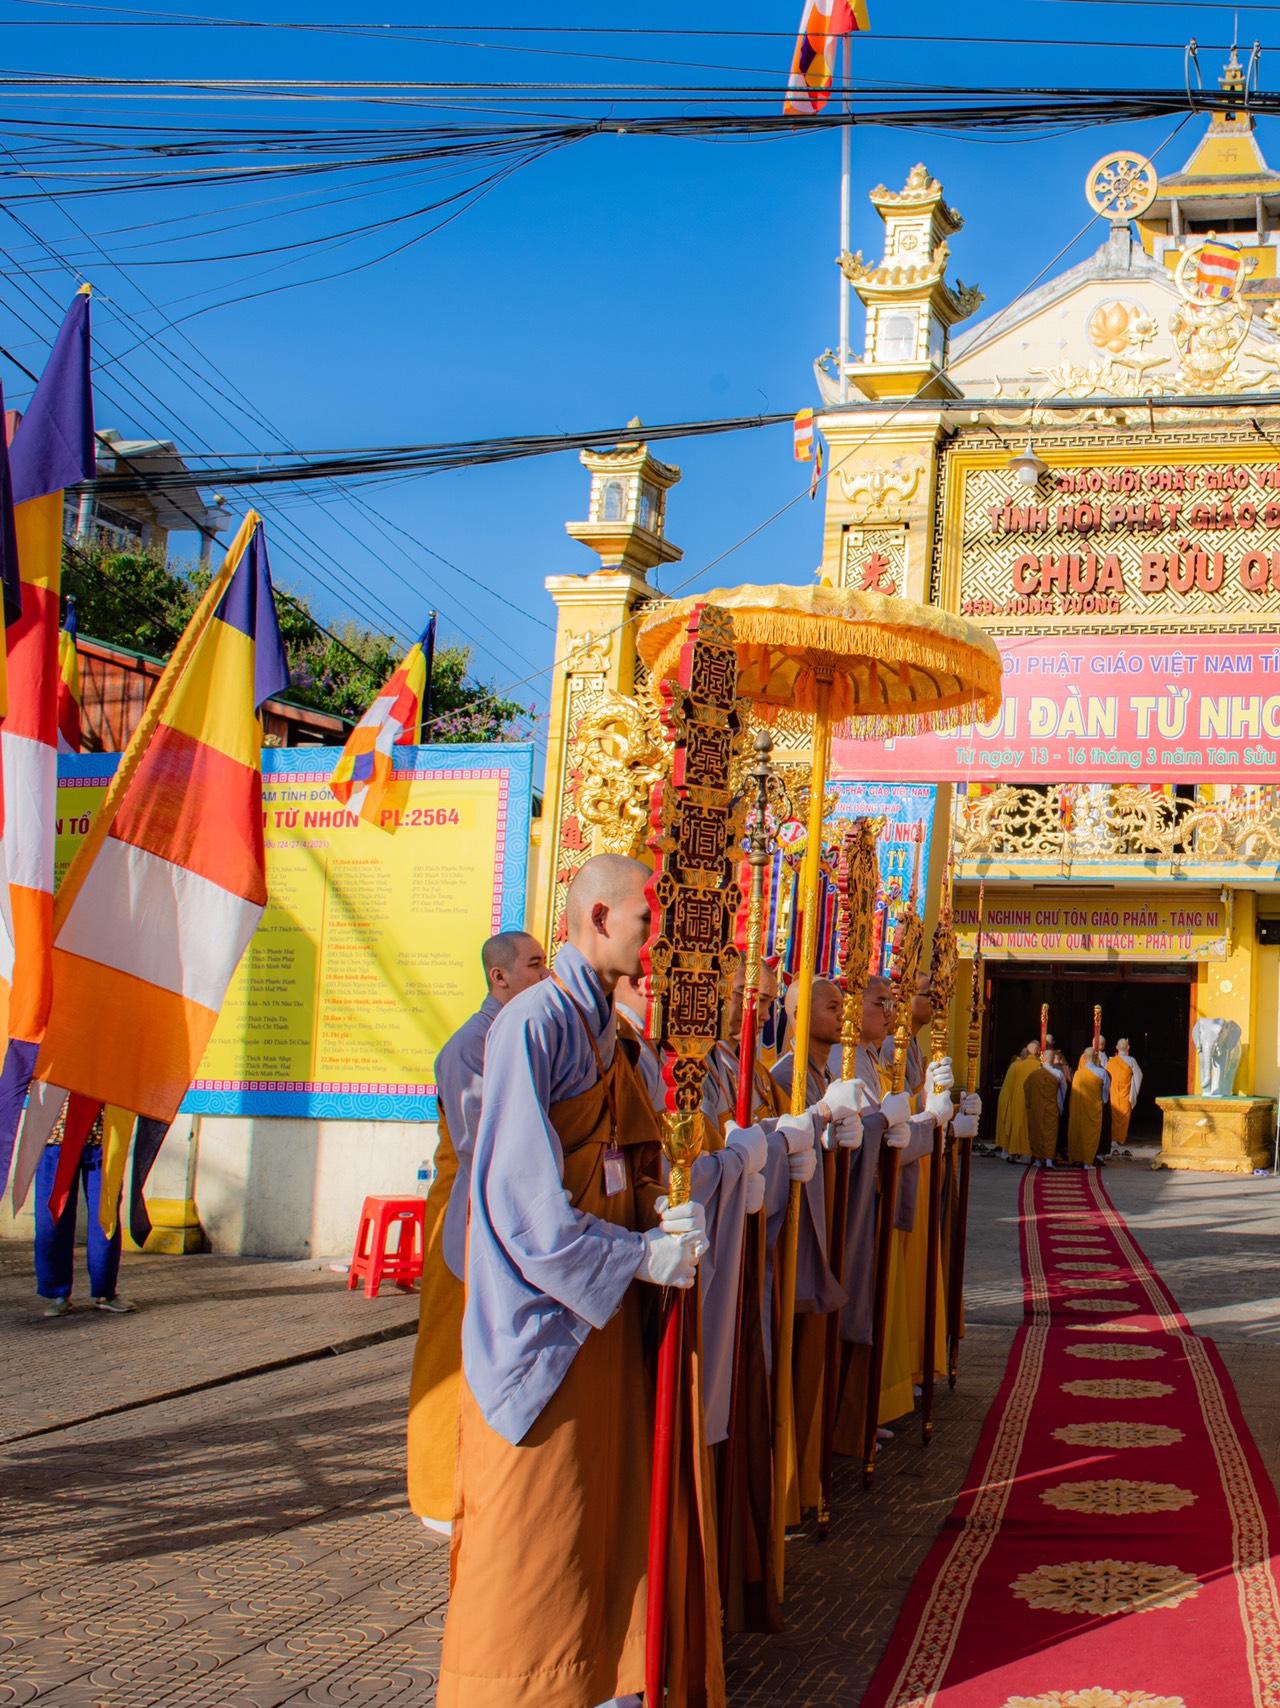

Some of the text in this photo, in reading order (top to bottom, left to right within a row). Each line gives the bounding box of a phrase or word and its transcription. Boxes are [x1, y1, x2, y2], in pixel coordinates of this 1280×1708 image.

[1057, 469, 1101, 493] GIÁO
[1108, 468, 1141, 498] HỘI
[1147, 468, 1199, 496] PHẬT
[1204, 466, 1250, 490] GIÁO
[1056, 498, 1102, 540] HỘI
[1110, 498, 1181, 536] PHẬT
[1191, 496, 1257, 530] GIÁO
[1011, 543, 1125, 595] CHÙA
[1141, 537, 1224, 593] BỬU
[1028, 652, 1084, 679] PHẬT
[1090, 651, 1144, 673] GIÁO
[1150, 651, 1198, 678] VIỆT
[1204, 655, 1253, 673] NAM
[1028, 684, 1118, 740] ĐÀN
[1129, 683, 1192, 740] TỪ
[955, 746, 976, 765] Từ
[978, 747, 1025, 768] ngày
[1031, 747, 1049, 765] 13
[1067, 747, 1087, 765] 16
[1090, 746, 1143, 768] tháng
[1146, 747, 1157, 765] 3
[1161, 746, 1202, 765] năm
[1206, 746, 1240, 765] Tân
[1243, 744, 1277, 765] Sửu
[262, 791, 277, 802] AM
[310, 786, 336, 801] ĐỒN
[69, 810, 92, 835] TỔ
[303, 808, 360, 829] NHƠN
[987, 909, 1032, 926] NGHINH
[1035, 908, 1061, 926] CHƯ
[1064, 907, 1088, 926] TÔN
[1091, 907, 1120, 927] GIÁO
[1123, 903, 1159, 927] PHẨM
[1206, 911, 1219, 927] NI
[1066, 932, 1094, 951] QUAN
[1098, 930, 1135, 949] KHÁCH
